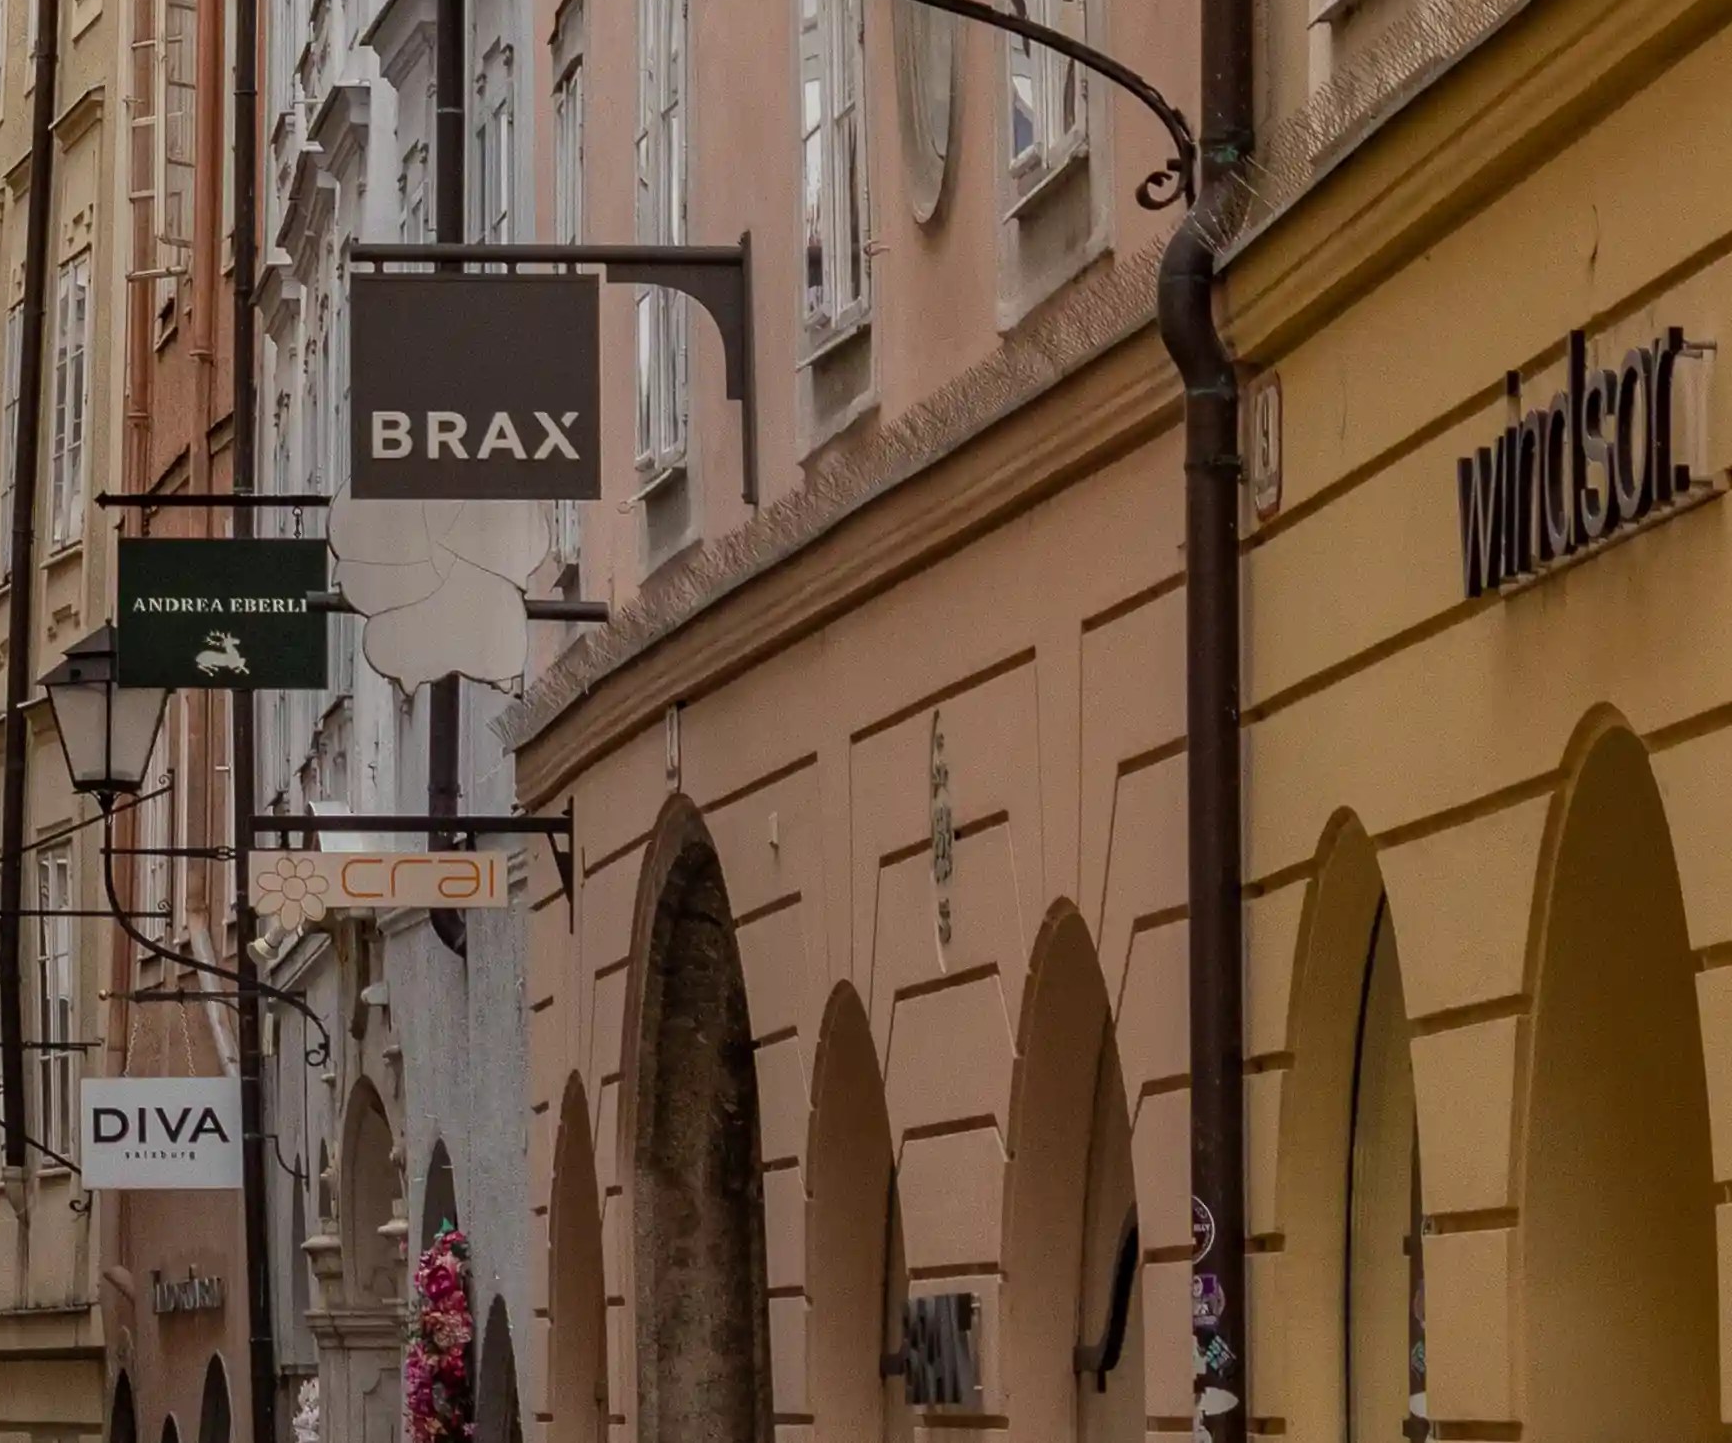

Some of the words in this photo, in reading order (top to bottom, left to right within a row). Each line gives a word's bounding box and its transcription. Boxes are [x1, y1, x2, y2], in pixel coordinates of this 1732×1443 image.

[371, 410, 581, 460] BRAX
[132, 597, 224, 613] ANDREA
[93, 1107, 231, 1144] DIVA
